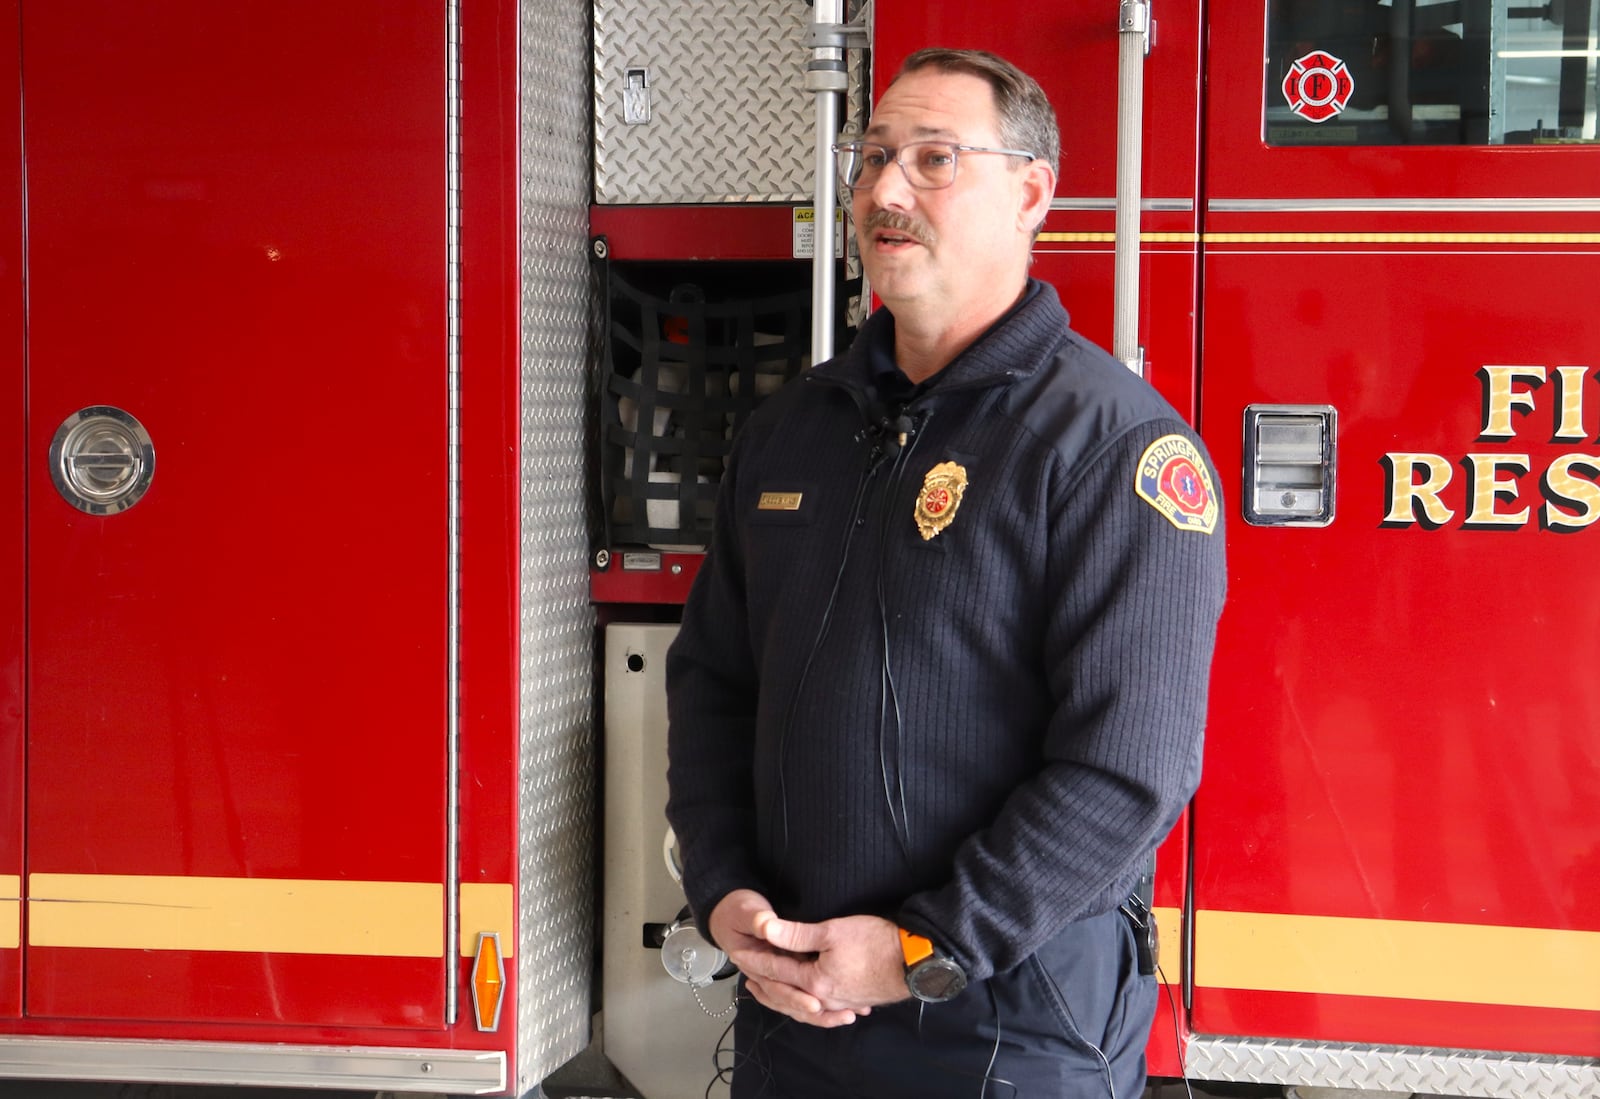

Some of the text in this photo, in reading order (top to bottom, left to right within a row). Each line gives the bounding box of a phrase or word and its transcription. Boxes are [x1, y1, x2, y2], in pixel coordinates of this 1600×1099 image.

[1313, 55, 1325, 66] A
[1312, 76, 1326, 98] F
[1338, 78, 1349, 96] F
[1475, 365, 1600, 442] FI
[1155, 495, 1177, 515] FIRE
